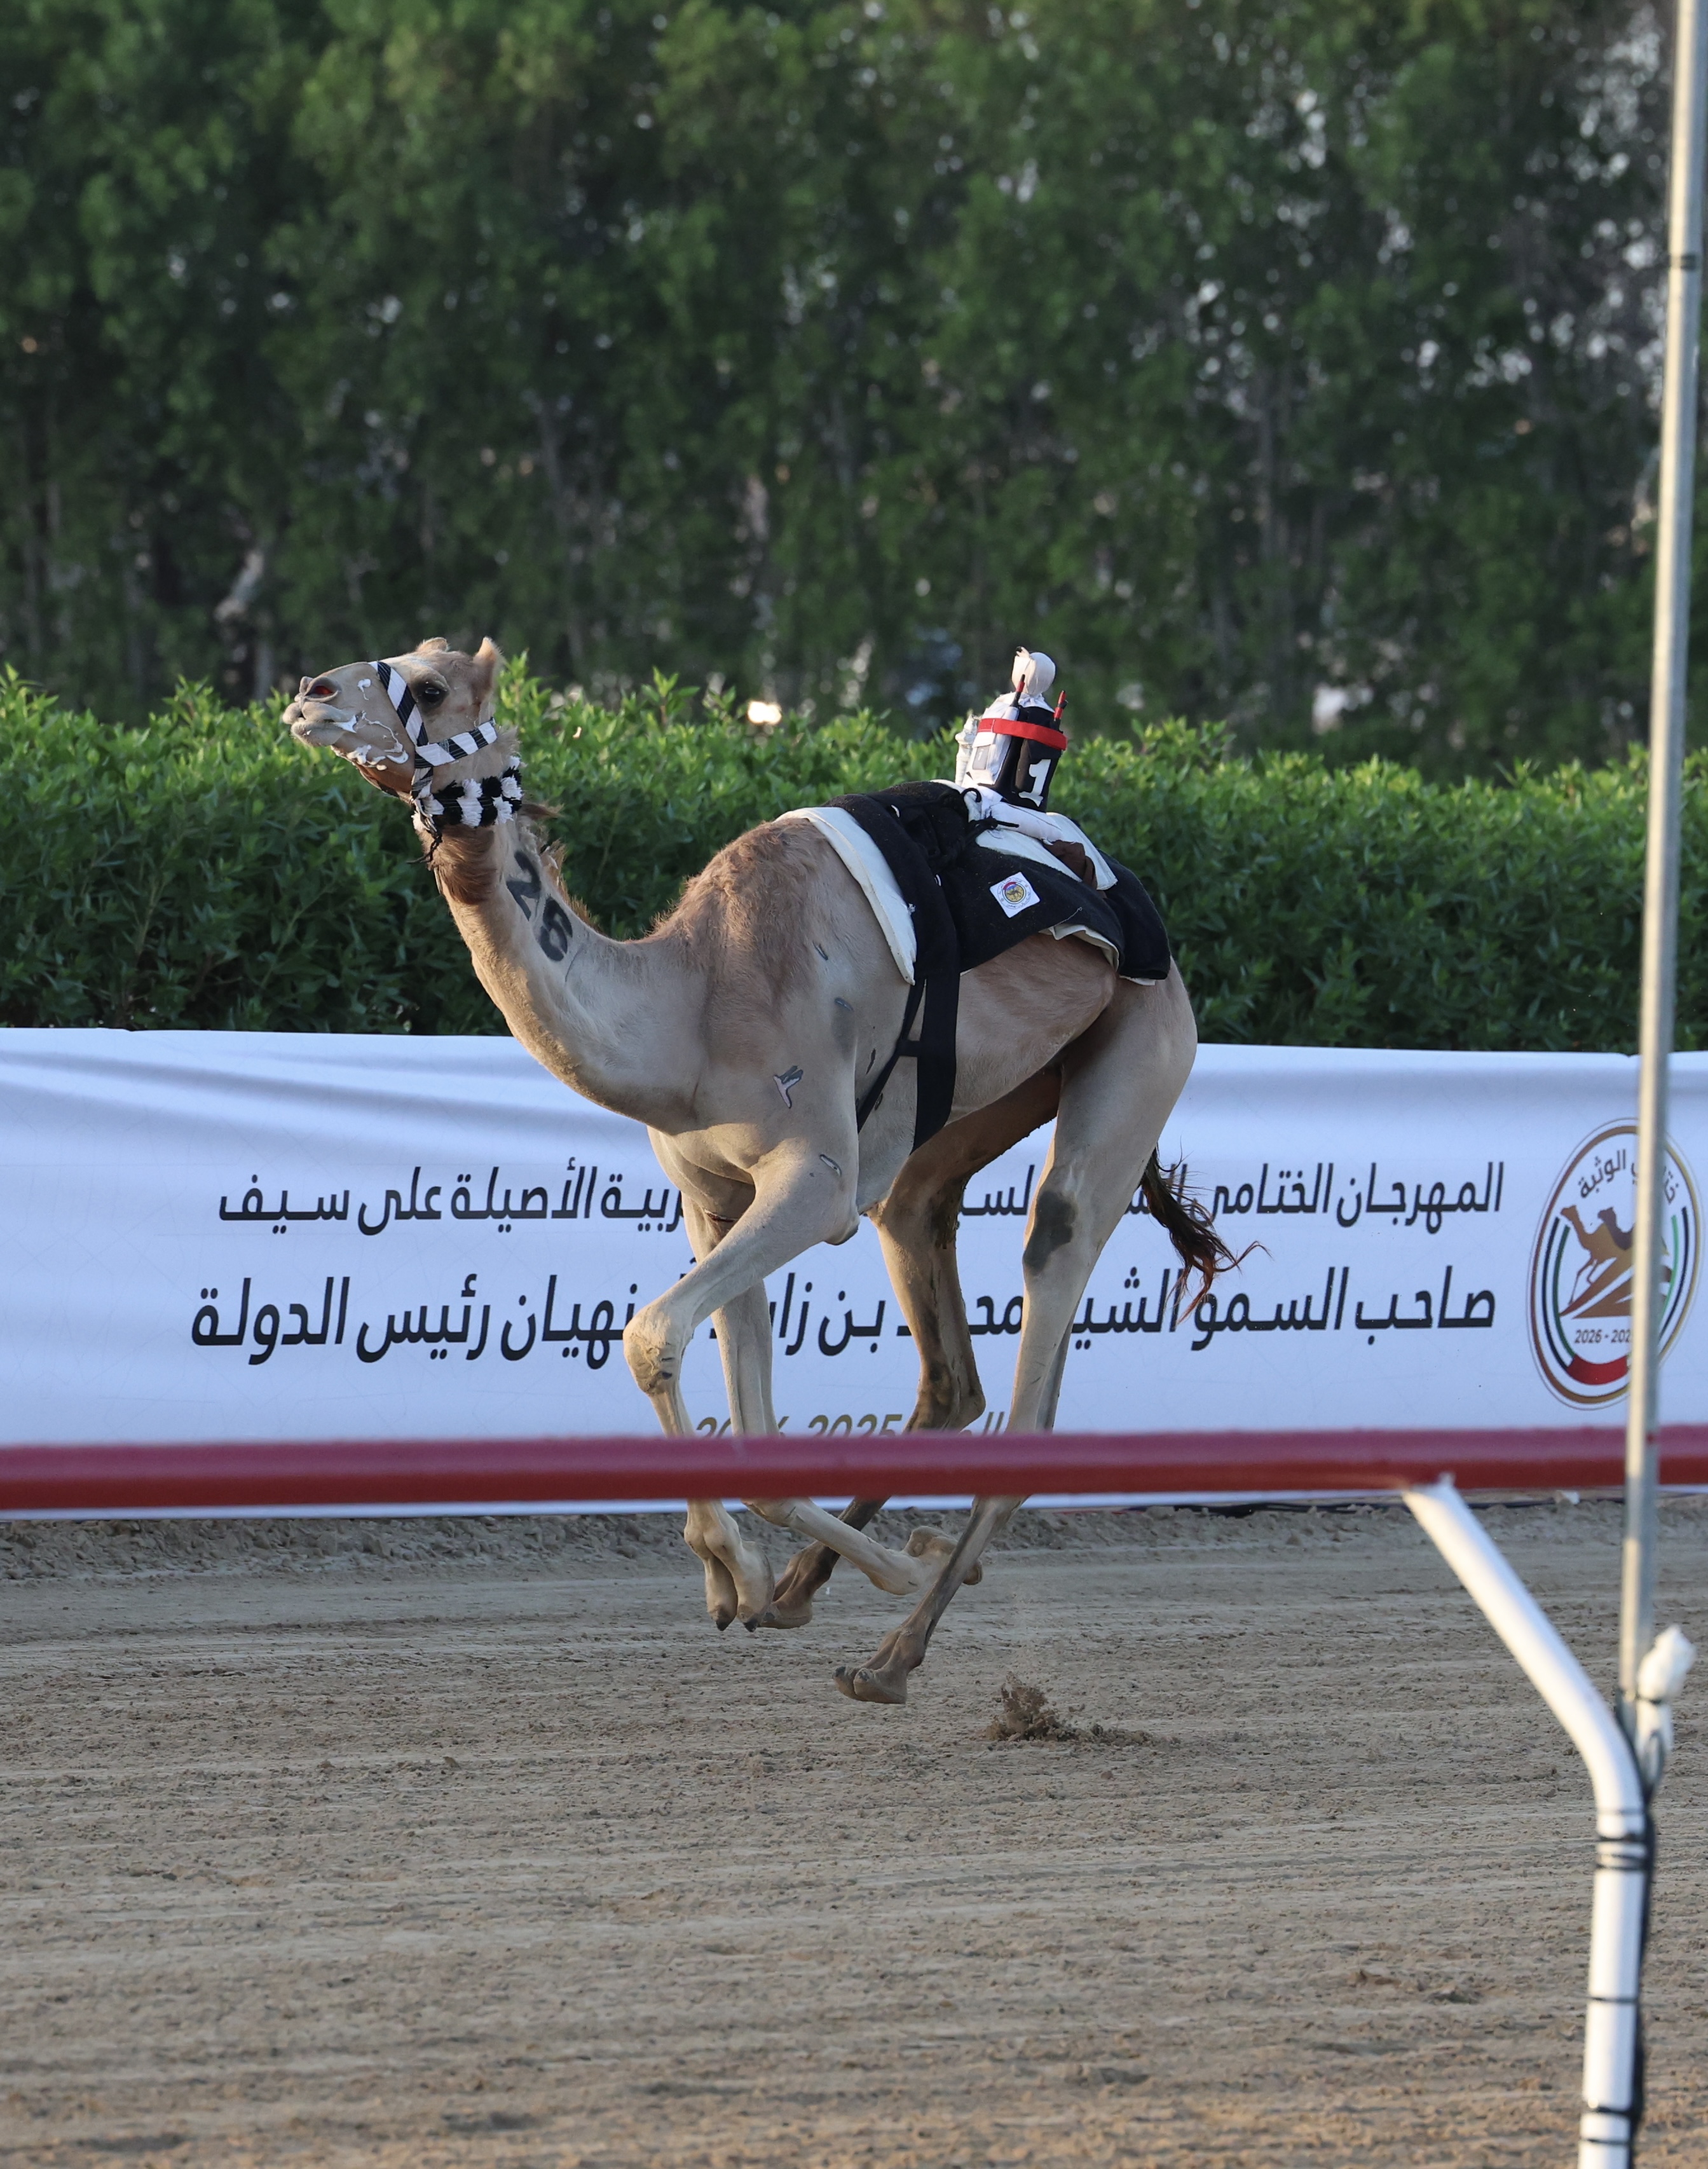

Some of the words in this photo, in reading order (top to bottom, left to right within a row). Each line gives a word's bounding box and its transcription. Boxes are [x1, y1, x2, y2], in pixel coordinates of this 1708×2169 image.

[1018, 759, 1051, 807] 1
[506, 851, 573, 961] 28
[219, 1174, 350, 1235] سيف
[357, 1166, 442, 1236] على
[451, 1157, 598, 1233] الأصيلة
[601, 1173, 685, 1233] ربية
[1336, 1162, 1503, 1235] المهرجان
[1580, 1149, 1626, 1198] الوثبة
[191, 1276, 350, 1365] الدولة
[356, 1273, 491, 1364] رئيس
[500, 1275, 638, 1370] نهيان
[817, 1290, 886, 1357] بن
[1072, 1266, 1184, 1350] الشي
[1191, 1266, 1349, 1351] السمو
[1355, 1265, 1496, 1345] صاحب
[1575, 1329, 1602, 1343] 2026
[1611, 1329, 1631, 1343] 202
